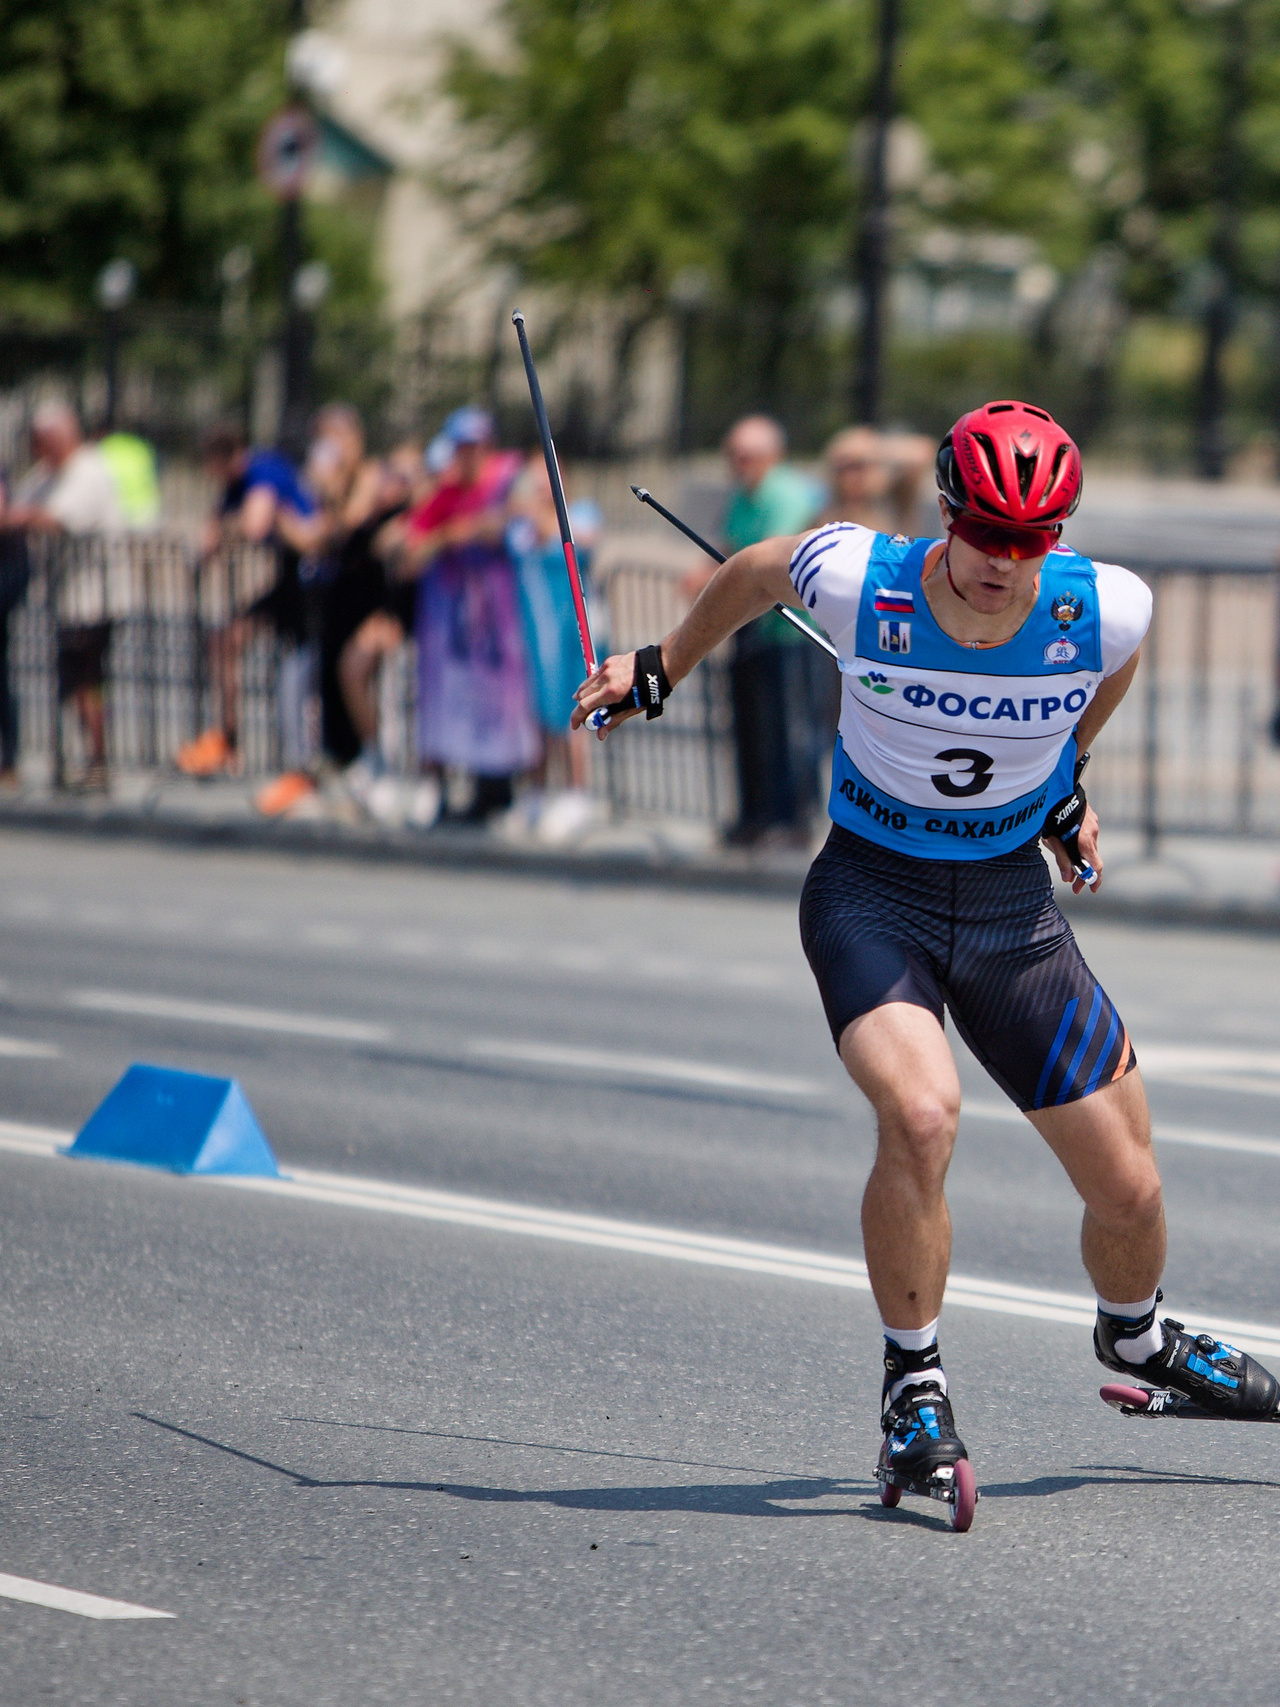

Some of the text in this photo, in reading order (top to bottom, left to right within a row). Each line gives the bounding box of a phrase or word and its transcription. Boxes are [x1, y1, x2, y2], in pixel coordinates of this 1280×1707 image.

[647, 673, 660, 705] SWIX
[903, 684, 1087, 722] ФОСАГРО
[930, 748, 994, 798] 3
[1054, 794, 1080, 825] SWIX
